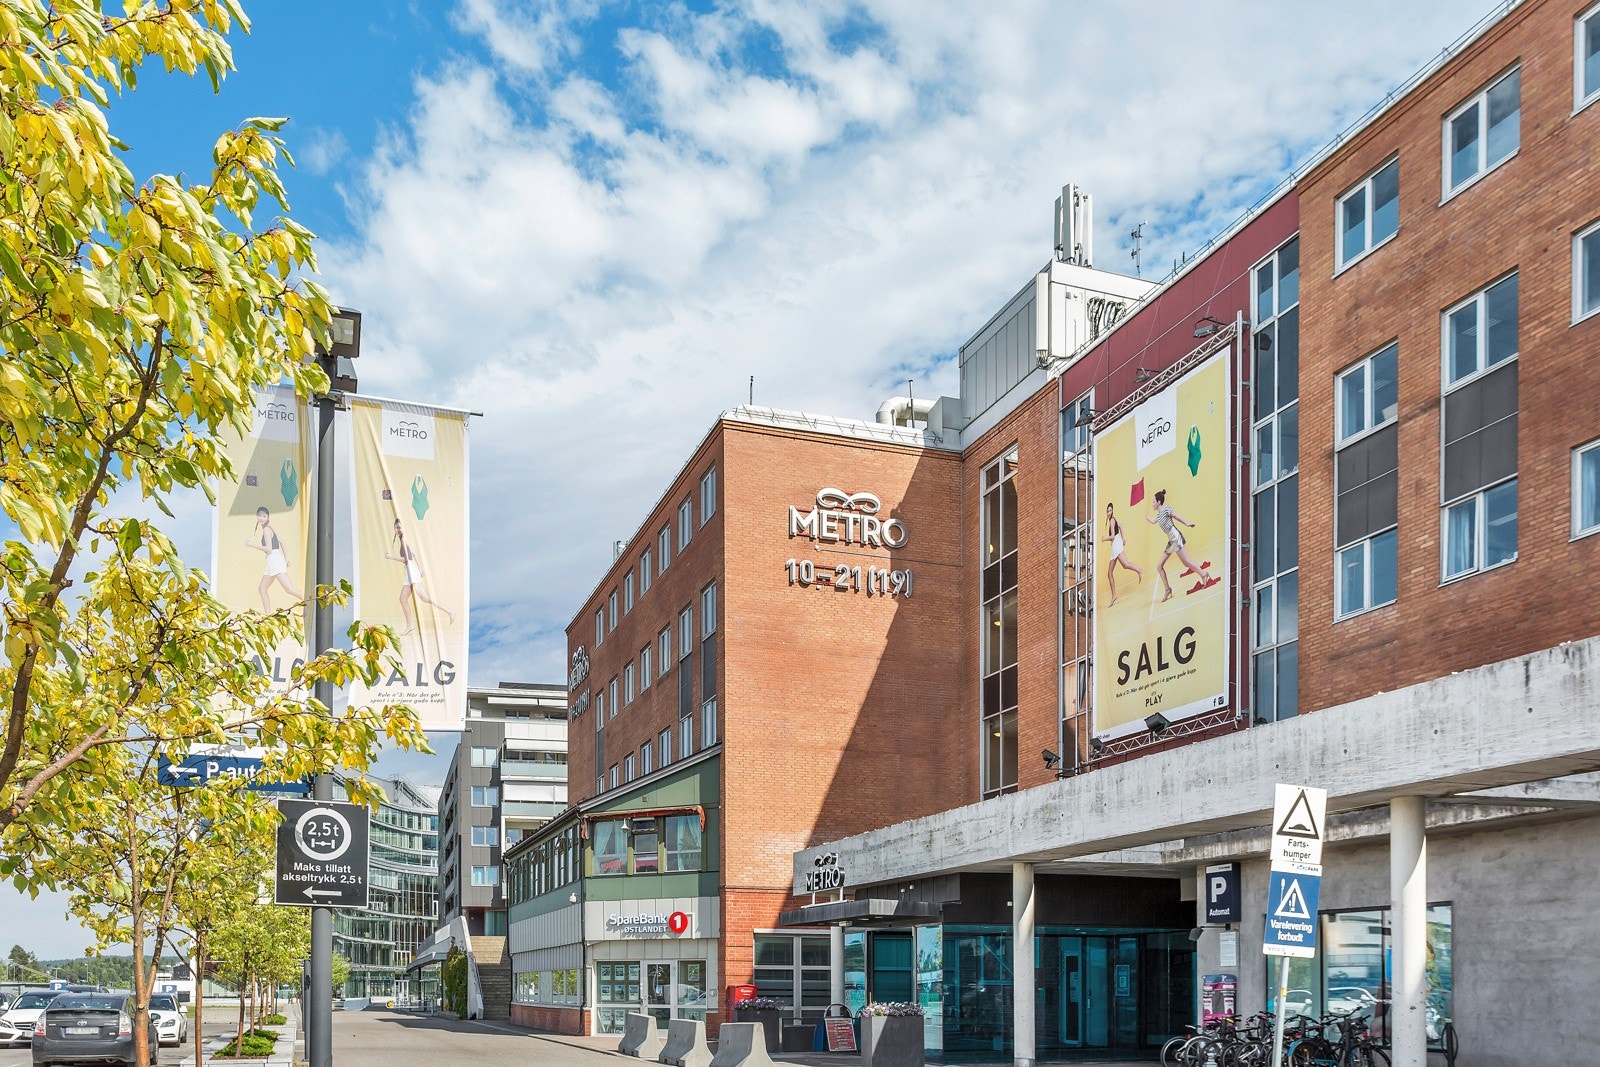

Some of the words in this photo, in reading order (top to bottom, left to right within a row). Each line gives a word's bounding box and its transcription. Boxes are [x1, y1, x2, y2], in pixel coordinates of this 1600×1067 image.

[257, 409, 295, 422] METRO
[389, 427, 428, 440] METRO
[1141, 421, 1171, 449] METRO
[788, 505, 909, 549] METRO
[1117, 626, 1197, 686] SALG
[1145, 694, 1163, 707] PLAY
[1287, 838, 1310, 849] Farts-
[1283, 849, 1311, 860] humper
[294, 862, 321, 873] Maks
[325, 864, 352, 874] tillatt
[282, 872, 336, 883] akseltrykk
[340, 875, 356, 885] 2,5
[806, 867, 842, 891] METRO
[1211, 876, 1227, 903] P
[1209, 907, 1230, 916] Automat
[609, 912, 668, 926] SpareBank
[673, 914, 682, 930] 1
[1270, 918, 1313, 933] Varelevering
[624, 925, 667, 933] ØSTLANDET
